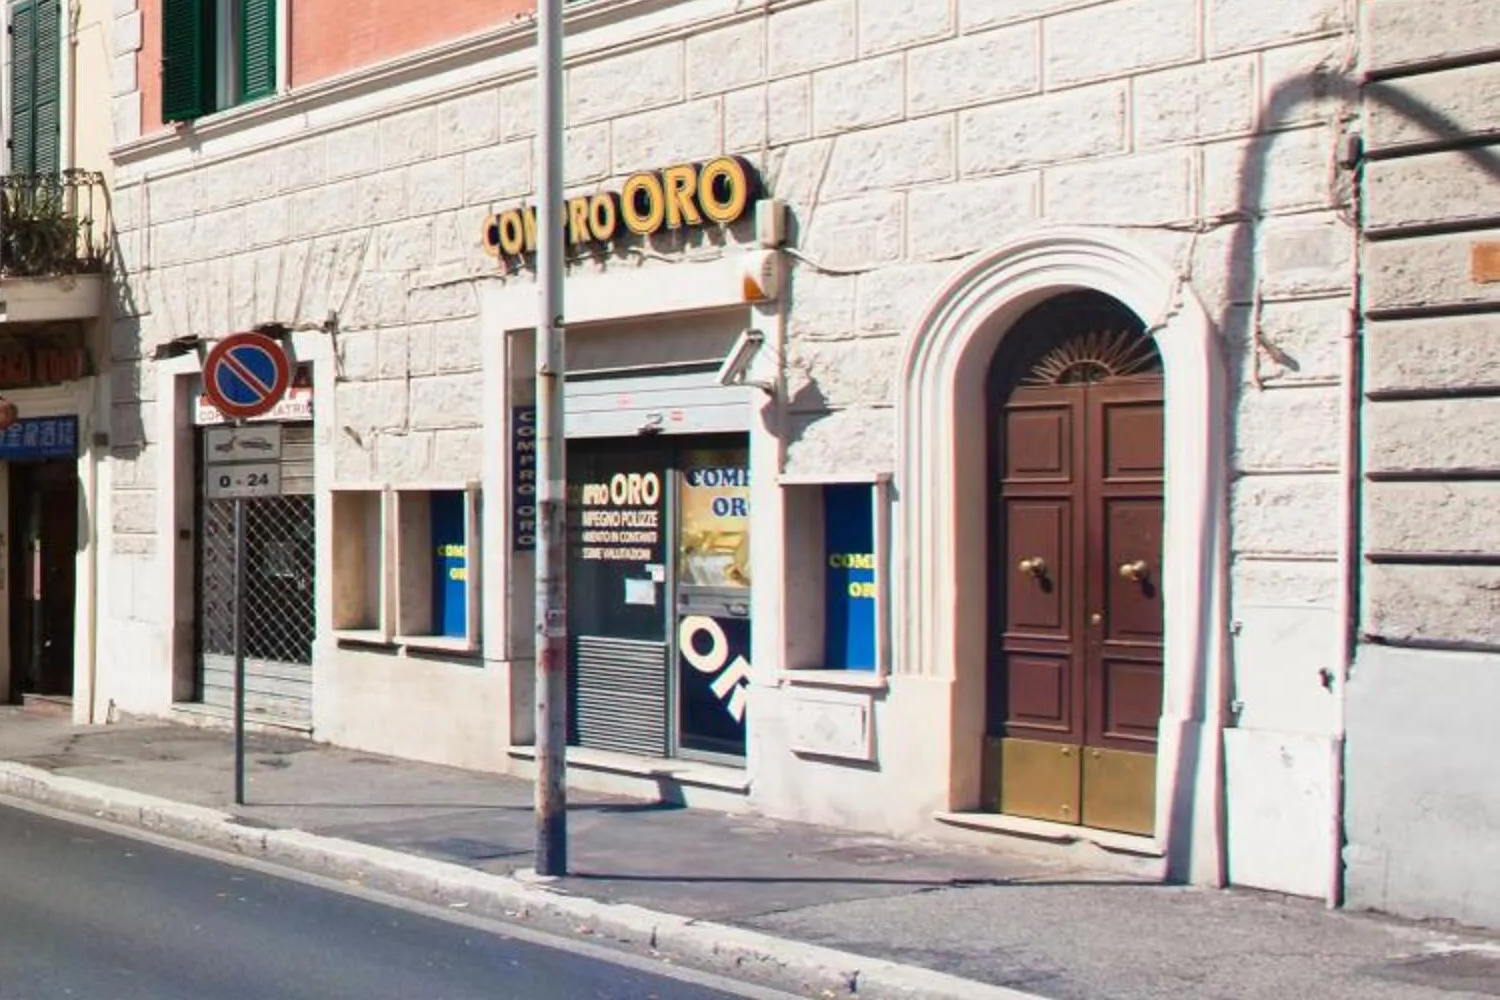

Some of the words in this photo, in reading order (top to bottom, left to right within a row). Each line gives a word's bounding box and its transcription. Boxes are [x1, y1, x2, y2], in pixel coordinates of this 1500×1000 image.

[621, 155, 747, 235] ORO
[516, 411, 535, 495] COMPRO
[219, 475, 231, 489] 0
[247, 472, 269, 488] 24
[610, 472, 660, 505] ORO
[712, 498, 750, 516] OR
[516, 508, 535, 545] ORO
